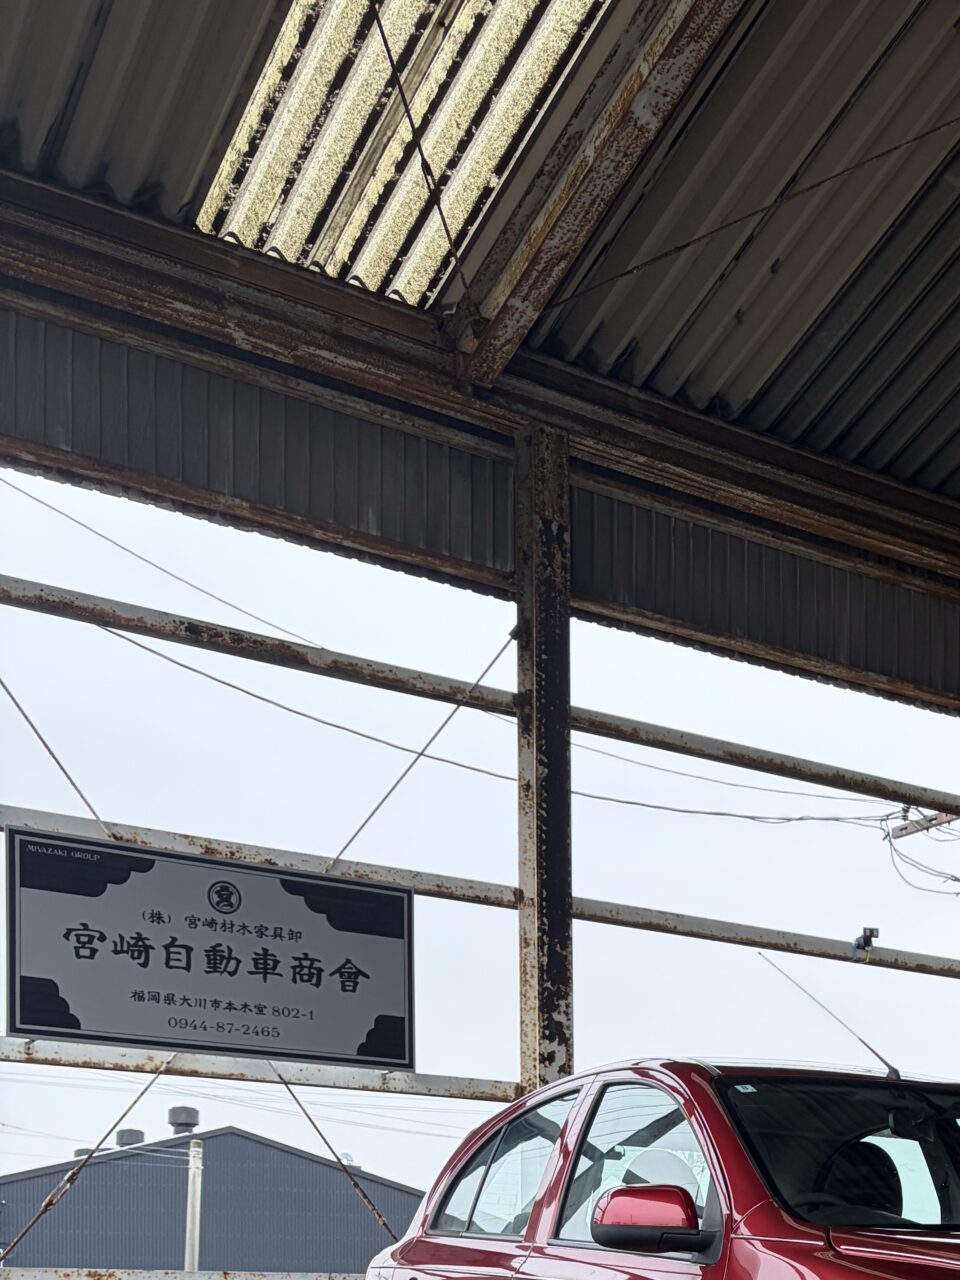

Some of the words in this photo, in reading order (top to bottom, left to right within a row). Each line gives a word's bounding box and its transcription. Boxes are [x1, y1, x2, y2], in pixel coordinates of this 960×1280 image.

[26, 844, 67, 857] MIYAZAKI
[71, 850, 100, 861] GROUP
[62, 922, 371, 993] 宮崎自動車商會
[271, 1005, 315, 1021] 802-1
[167, 1016, 280, 1039] 0944-87-2465
